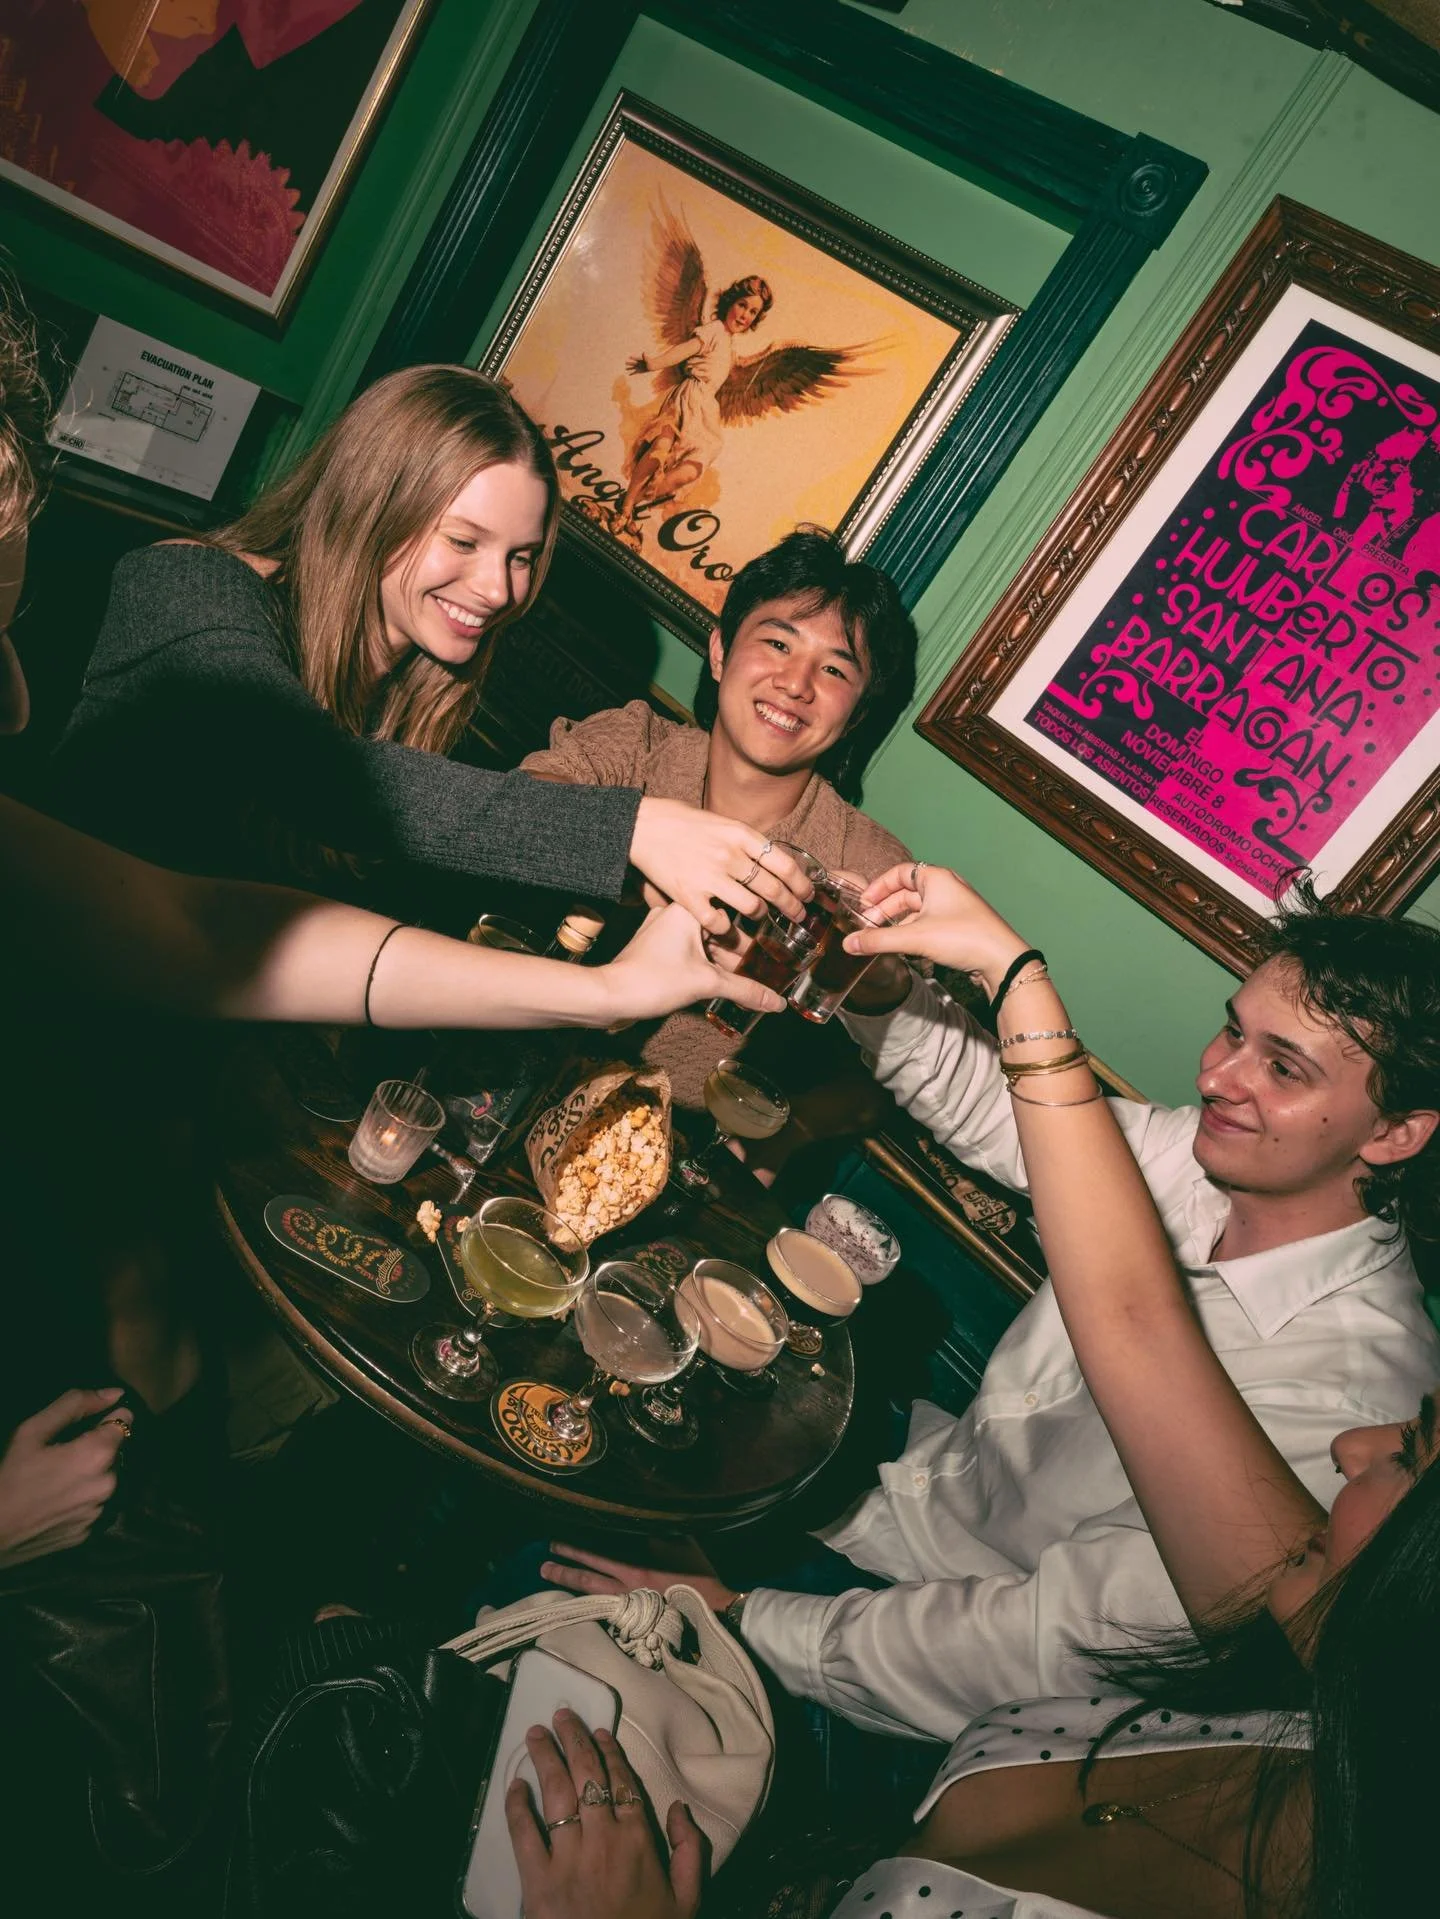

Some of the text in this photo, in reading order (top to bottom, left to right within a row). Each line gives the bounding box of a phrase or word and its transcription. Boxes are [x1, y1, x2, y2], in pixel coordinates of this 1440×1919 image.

[140, 350, 215, 390] EVACUATION PLAN
[1238, 503, 1431, 631] CARLOS
[1332, 526, 1354, 545] ORO
[1362, 543, 1411, 576] PRESENTA
[1173, 526, 1420, 691] HUMBERTO
[1161, 583, 1364, 737] SANTANA
[1042, 700, 1084, 734] TAQUILLAS
[1082, 729, 1121, 760] ABIERTAS
[1125, 760, 1143, 776] LAS
[1109, 615, 1353, 787] BARRAGÁN
[1184, 727, 1205, 749] EL
[1034, 710, 1073, 744] TODOS
[1070, 738, 1096, 760] LOS
[1091, 754, 1152, 800] ASIENTOS
[1150, 791, 1227, 854] RESERVADOS
[1120, 730, 1226, 810] NOVIEMBRE 8
[1144, 723, 1225, 785] DOMINGO
